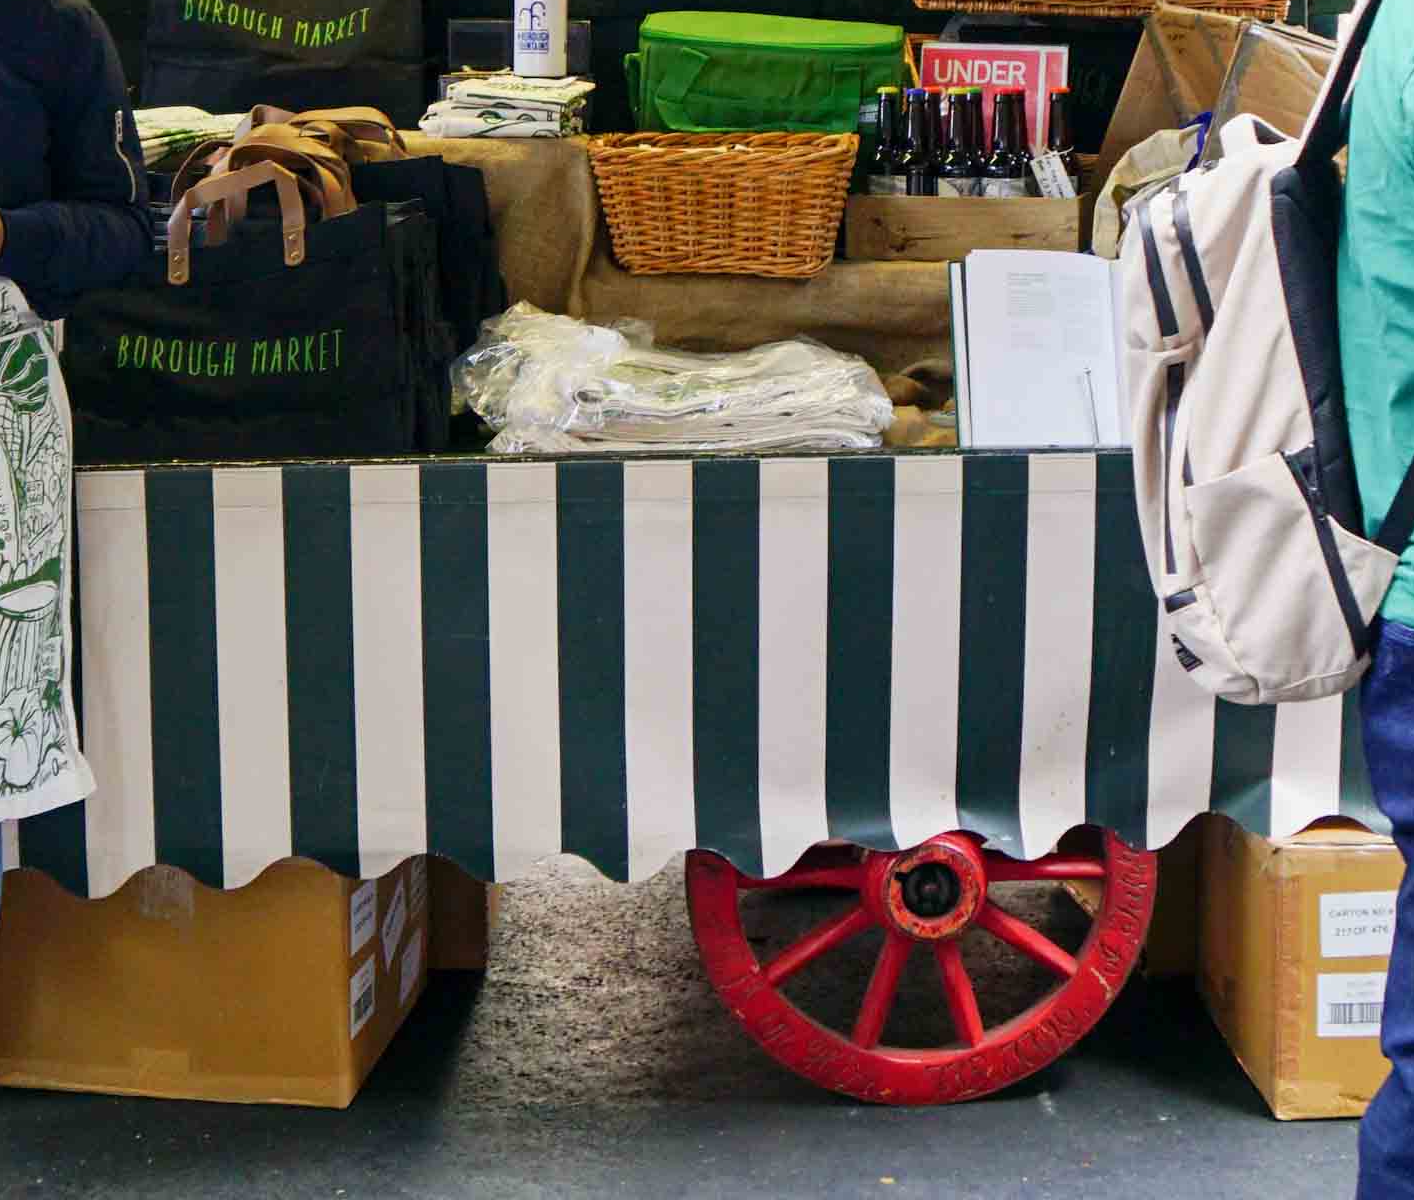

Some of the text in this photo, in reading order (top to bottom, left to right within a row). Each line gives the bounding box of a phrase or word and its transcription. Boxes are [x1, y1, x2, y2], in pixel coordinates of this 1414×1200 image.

[294, 6, 372, 49] MARKET
[934, 58, 1027, 86] UNDER
[117, 328, 345, 377] BOROUGH MARKET
